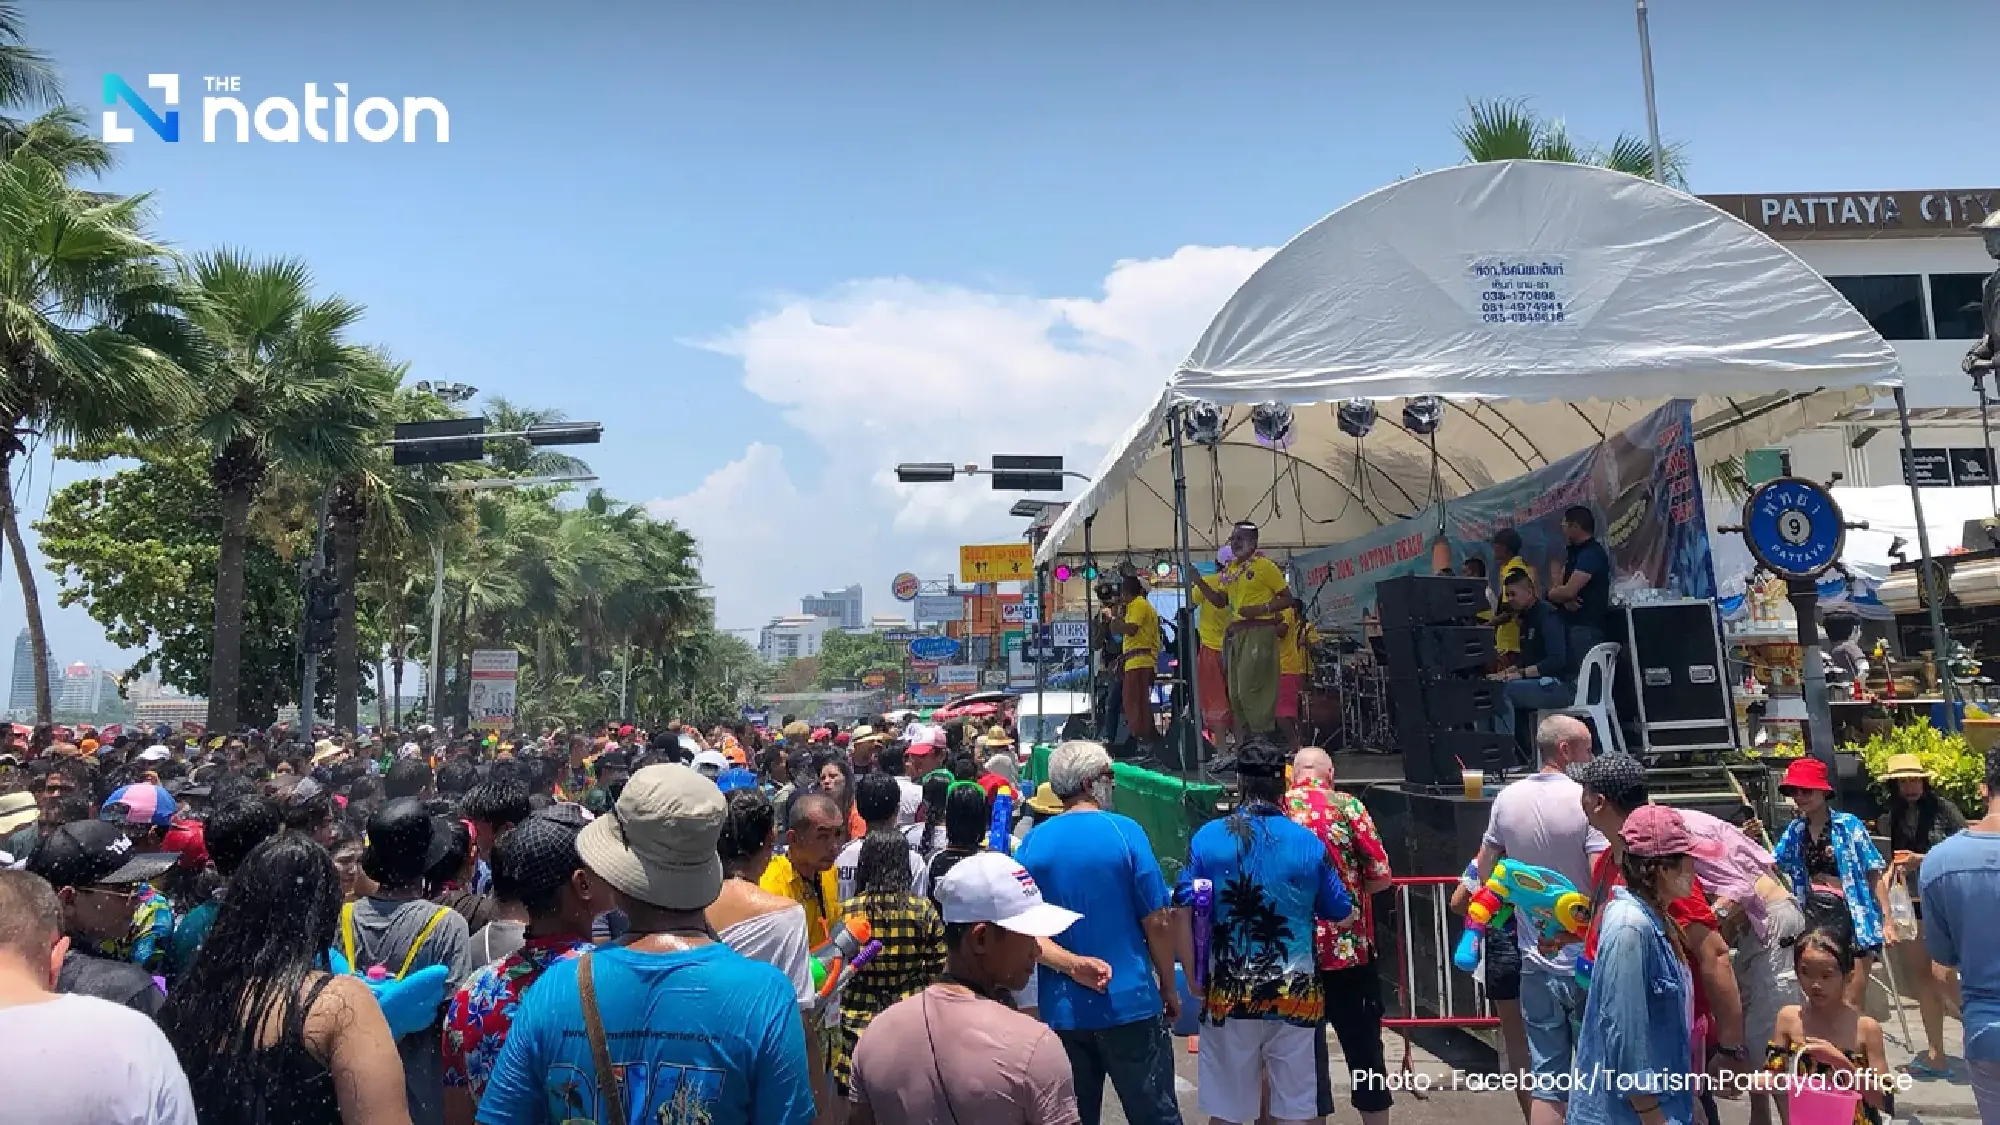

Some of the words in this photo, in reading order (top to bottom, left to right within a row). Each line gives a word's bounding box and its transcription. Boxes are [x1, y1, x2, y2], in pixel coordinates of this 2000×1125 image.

[1761, 195, 1900, 226] PATTAYA
[1919, 193, 1992, 222] CITY
[1789, 518, 1801, 536] 9
[1771, 543, 1826, 563] PATTAYA
